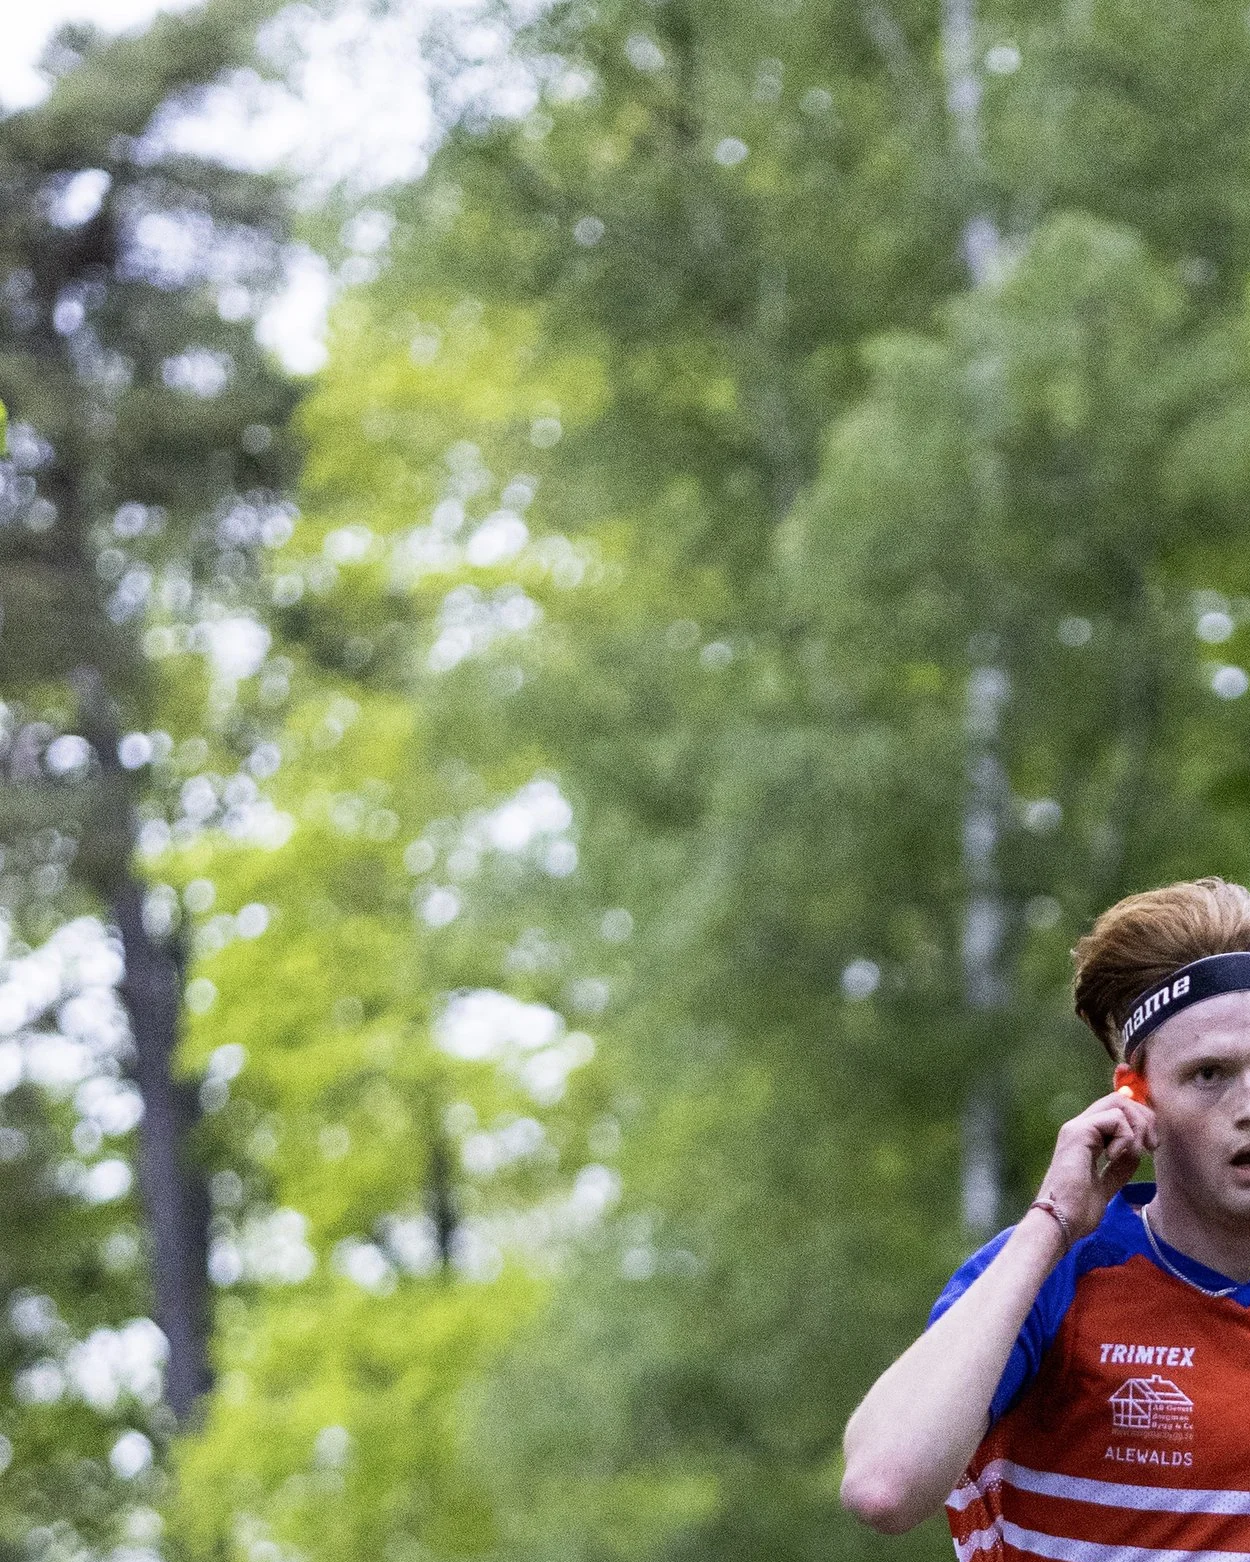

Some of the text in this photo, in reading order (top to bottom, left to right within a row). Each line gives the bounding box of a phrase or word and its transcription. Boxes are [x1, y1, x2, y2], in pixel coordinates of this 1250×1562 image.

[1122, 975, 1191, 1043] name
[1100, 1343, 1195, 1367] TRIMTEX
[1104, 1446, 1193, 1466] ALEWALDS
